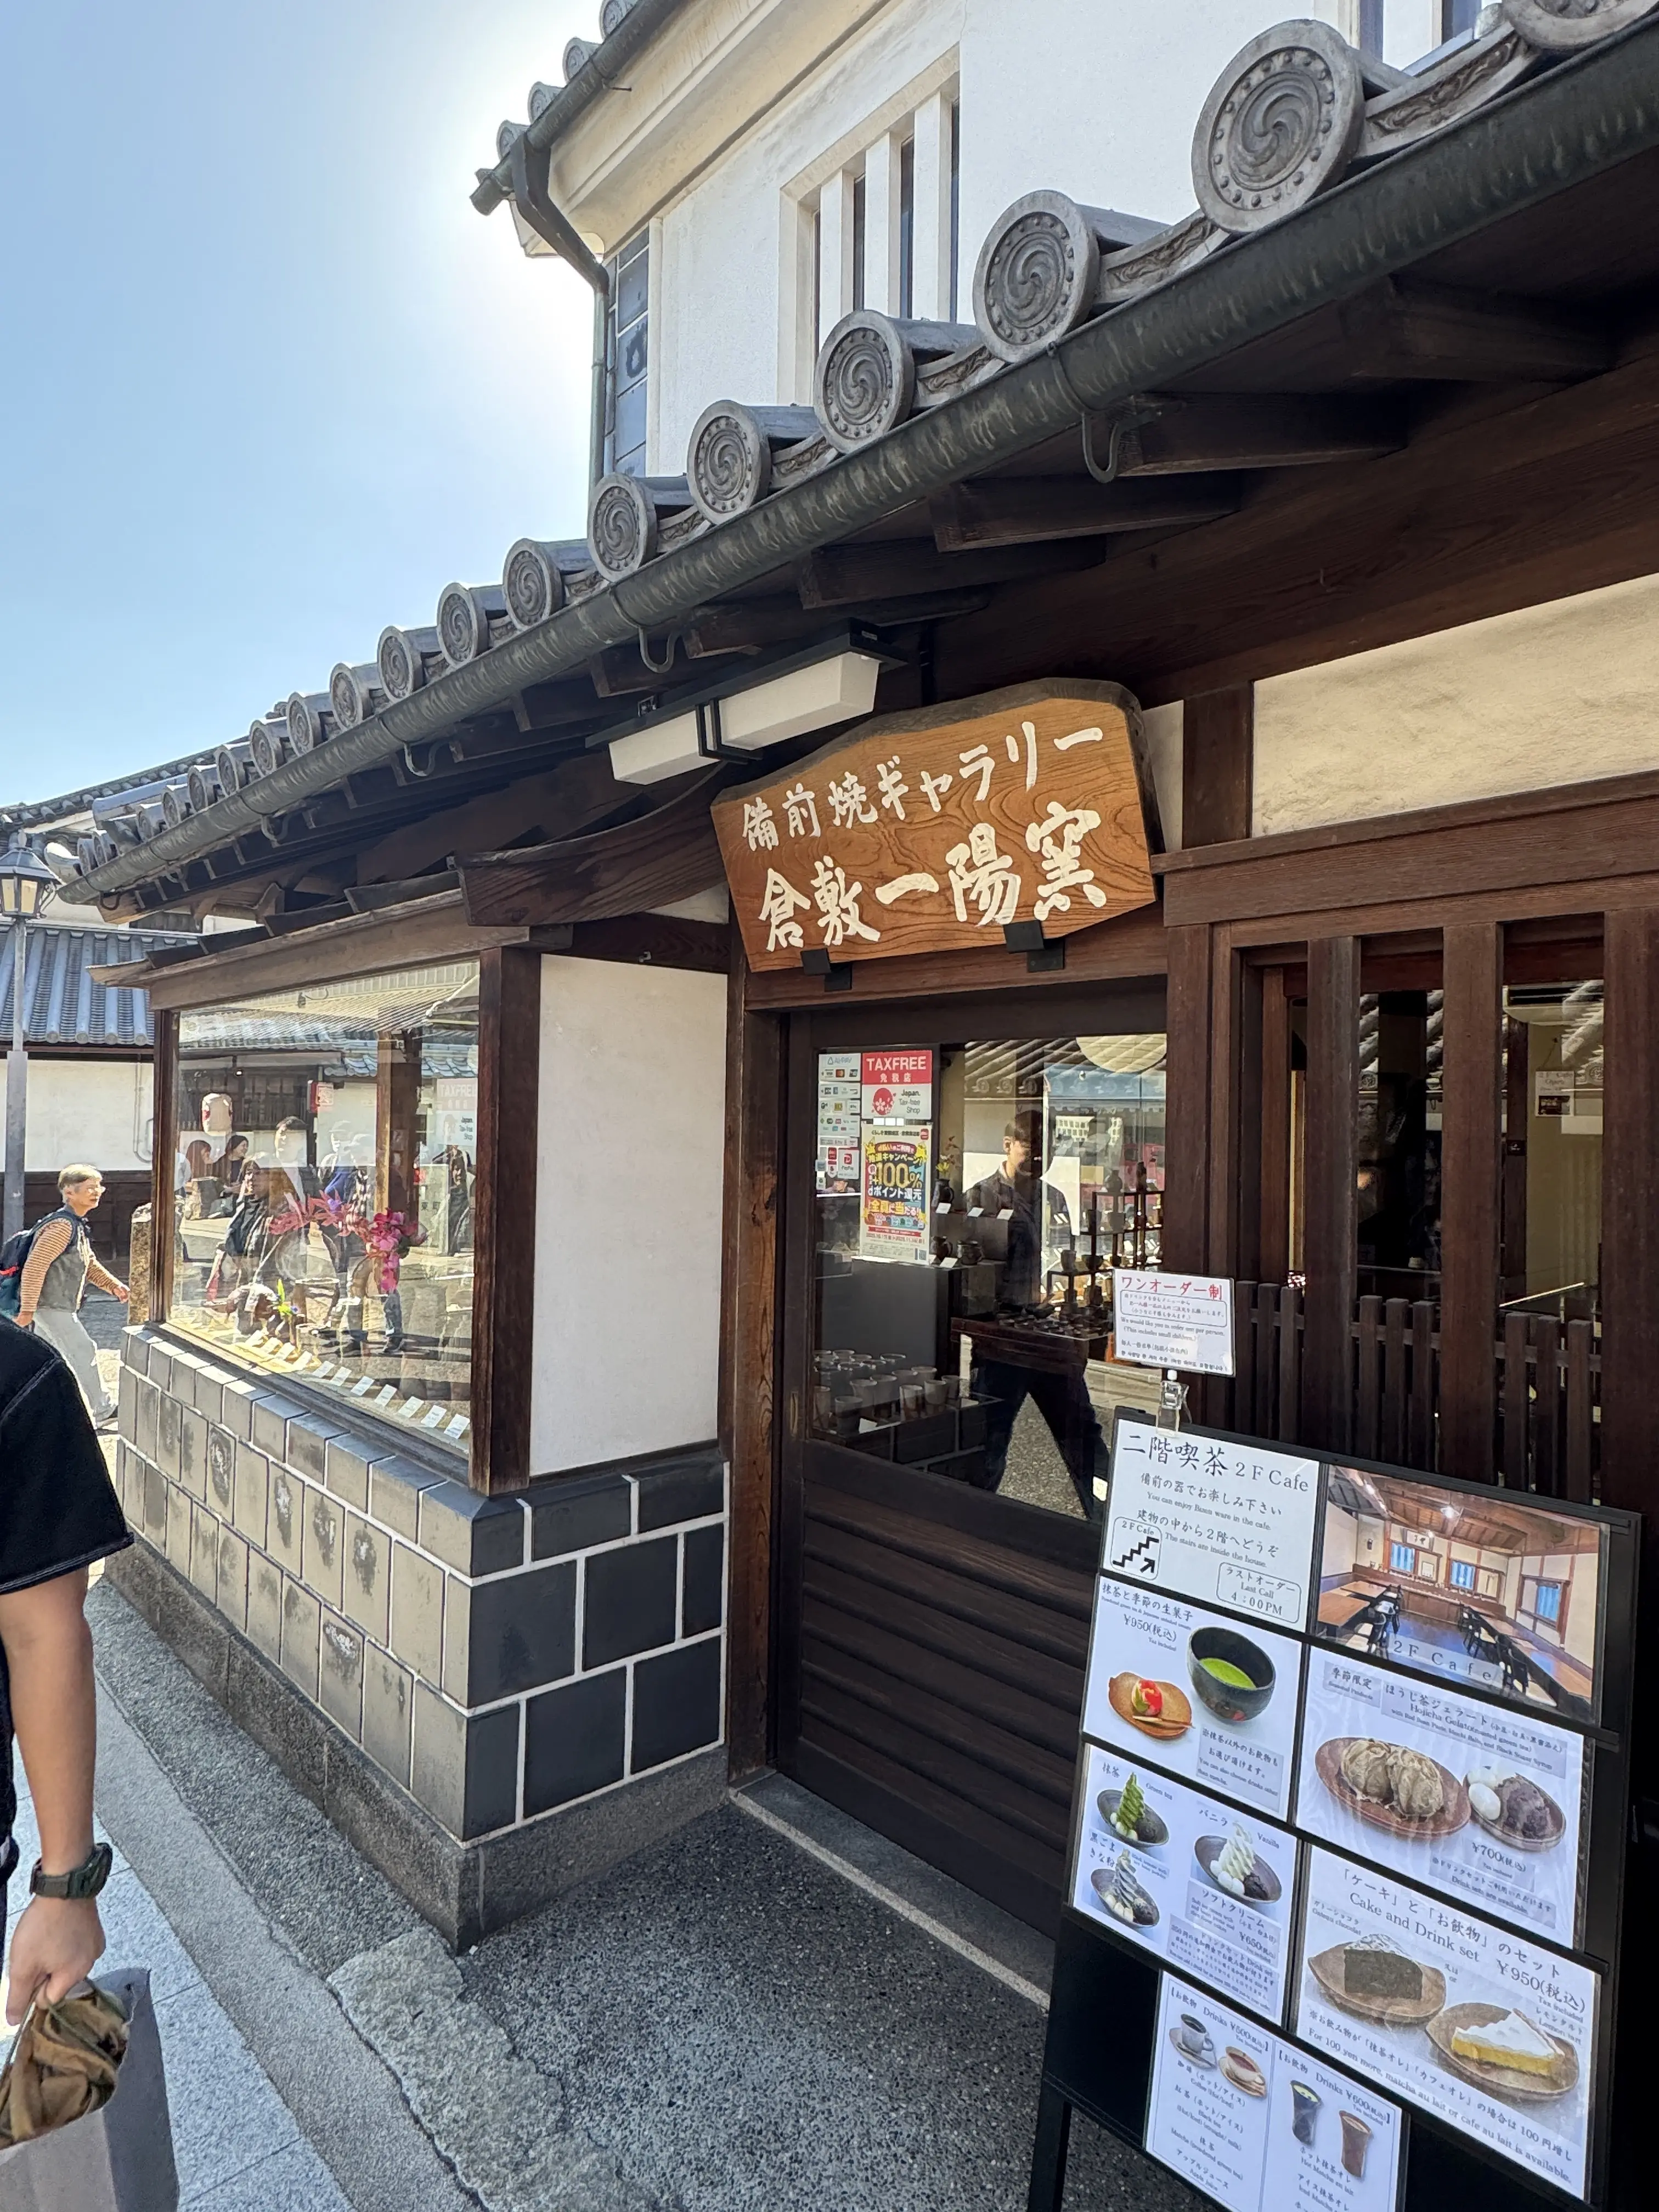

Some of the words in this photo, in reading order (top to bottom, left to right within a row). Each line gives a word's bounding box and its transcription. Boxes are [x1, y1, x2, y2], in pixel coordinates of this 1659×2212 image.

[742, 721, 1103, 851] 備前焼ギャラリー
[758, 801, 1107, 952] 倉敷一陽窯
[866, 1056, 926, 1071] TAXFREE
[880, 1073, 911, 1082] 免税店
[906, 1107, 920, 1115] Shop
[868, 1186, 922, 1200] dポイント還元
[1121, 1276, 1222, 1300] ワンオーダー制
[1123, 1435, 1228, 1476] 二階喫茶
[1268, 1470, 1308, 1492] Cafe
[1141, 1472, 1281, 1515] 備前の器でお楽しみ下さい
[1146, 1491, 1160, 1502] You
[1161, 1497, 1173, 1505] can
[1174, 1500, 1193, 1511] enjoy
[1215, 1510, 1231, 1520] ware
[1233, 1514, 1240, 1522] in
[1242, 1516, 1253, 1526] the
[1136, 1524, 1154, 1536] Cafe
[1137, 1509, 1278, 1558] 建物の中から2階へどうぞ
[1165, 1532, 1178, 1543] The
[1179, 1538, 1197, 1548] stairs
[1210, 1545, 1230, 1557] inside
[1232, 1551, 1243, 1561] the
[1244, 1554, 1267, 1568] house.
[1226, 1566, 1295, 1592] ラストオーダー
[1240, 1582, 1256, 1593] Last
[1259, 1587, 1274, 1599] Call
[1102, 1583, 1193, 1621] 抹茶と季節の生菓子
[1331, 1667, 1372, 1690] 季節限定
[1385, 1684, 1487, 1725] ほうじ茶ジェラート
[1410, 1702, 1442, 1722] Hojicha
[1102, 1762, 1120, 1778] 抹茶
[1146, 1782, 1163, 1796] Green
[1199, 1809, 1228, 1827] バニラ
[1090, 1831, 1115, 1853] 黒ごま
[1257, 1832, 1280, 1849] Vanilla
[1090, 1847, 1115, 1867] きな粉
[1451, 1875, 1471, 1889] Drink
[1202, 1889, 1265, 1928] ソフトクリーム
[1313, 1900, 1359, 1925] ガトーショコラ
[1335, 1919, 1361, 1936] chocolat
[1349, 1892, 1382, 1916] Cake
[1385, 1912, 1410, 1930] and
[1415, 1921, 1455, 1951] Drink
[1459, 1946, 1479, 1962] set
[1201, 1932, 1244, 1961] ドリンクセット
[1246, 1957, 1263, 1972] Drink
[1203, 2006, 1228, 2027] Drinks
[1536, 2006, 1582, 2035] レモンタルト
[1537, 1995, 1551, 2008] Tax
[1553, 2003, 1584, 2024] included
[1538, 2017, 1566, 2036] Lemon
[1315, 2072, 1343, 2096] Drinks
[1308, 2027, 1322, 2041] For
[1325, 2037, 1340, 2052] 100
[1342, 2048, 1357, 2062] yen
[1359, 2058, 1383, 2077] more,
[1385, 2072, 1416, 2095] matcha
[1418, 2091, 1429, 2103] au
[1432, 2096, 1446, 2112] lait
[1448, 2108, 1458, 2119] or
[1460, 2115, 1480, 2130] cafe
[1482, 2127, 1494, 2139] au
[1497, 2132, 1512, 2149] lait
[1515, 2142, 1523, 2155] is
[1525, 2152, 1571, 2183] available.
[1199, 2136, 1215, 2152] 抹茶
[1176, 2148, 1228, 2190] アップルジュース
[1300, 2146, 1351, 2183] ホット抹茶オレ
[1297, 2173, 1349, 2212] アイス抹茶オレ
